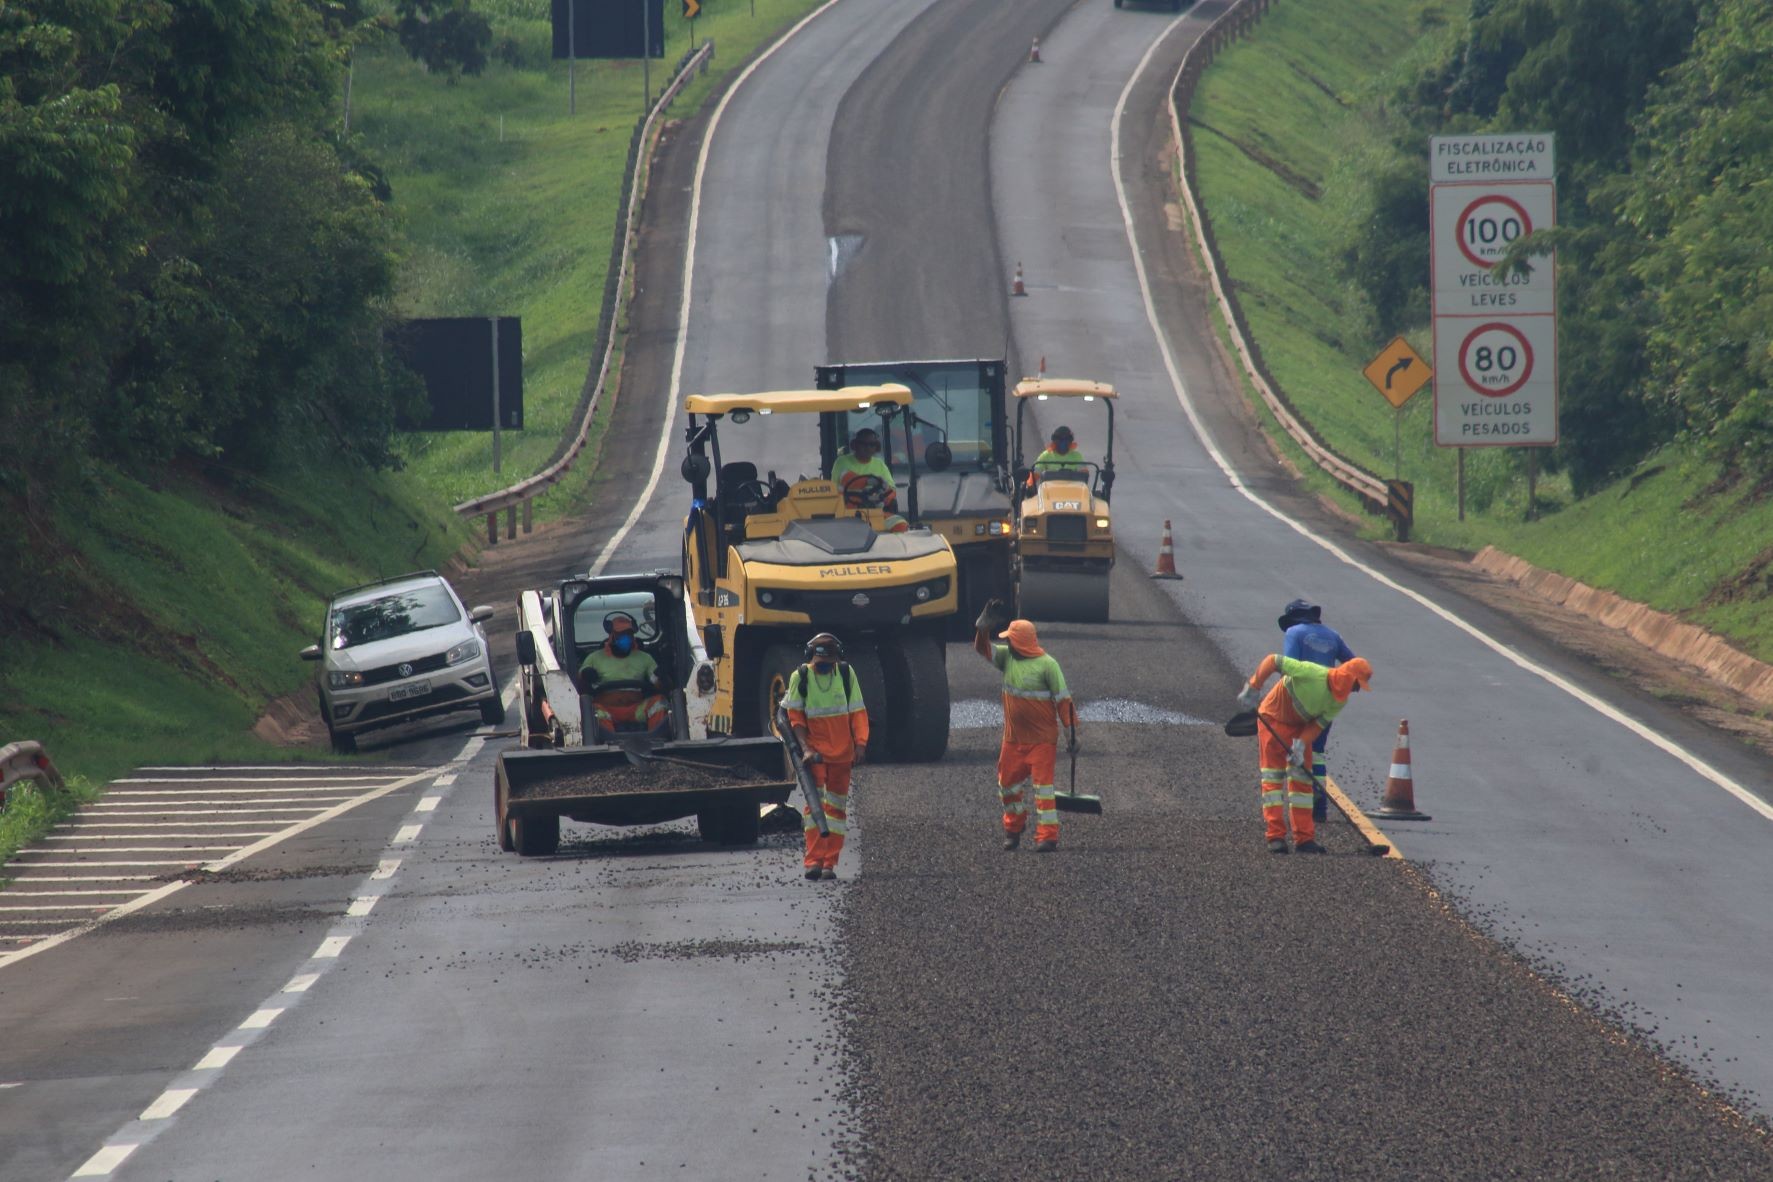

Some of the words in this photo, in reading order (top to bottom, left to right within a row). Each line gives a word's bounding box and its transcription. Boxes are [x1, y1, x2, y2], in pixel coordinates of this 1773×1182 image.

[1448, 158, 1537, 174] ELETRÔNICA
[1468, 217, 1520, 244] 100
[1471, 293, 1517, 306] LEVES
[1475, 346, 1516, 371] 80
[1481, 374, 1509, 384] km/h
[1460, 400, 1531, 416] VEÍCULOS
[1462, 422, 1530, 436] PESADOS
[1055, 500, 1080, 510] CAT
